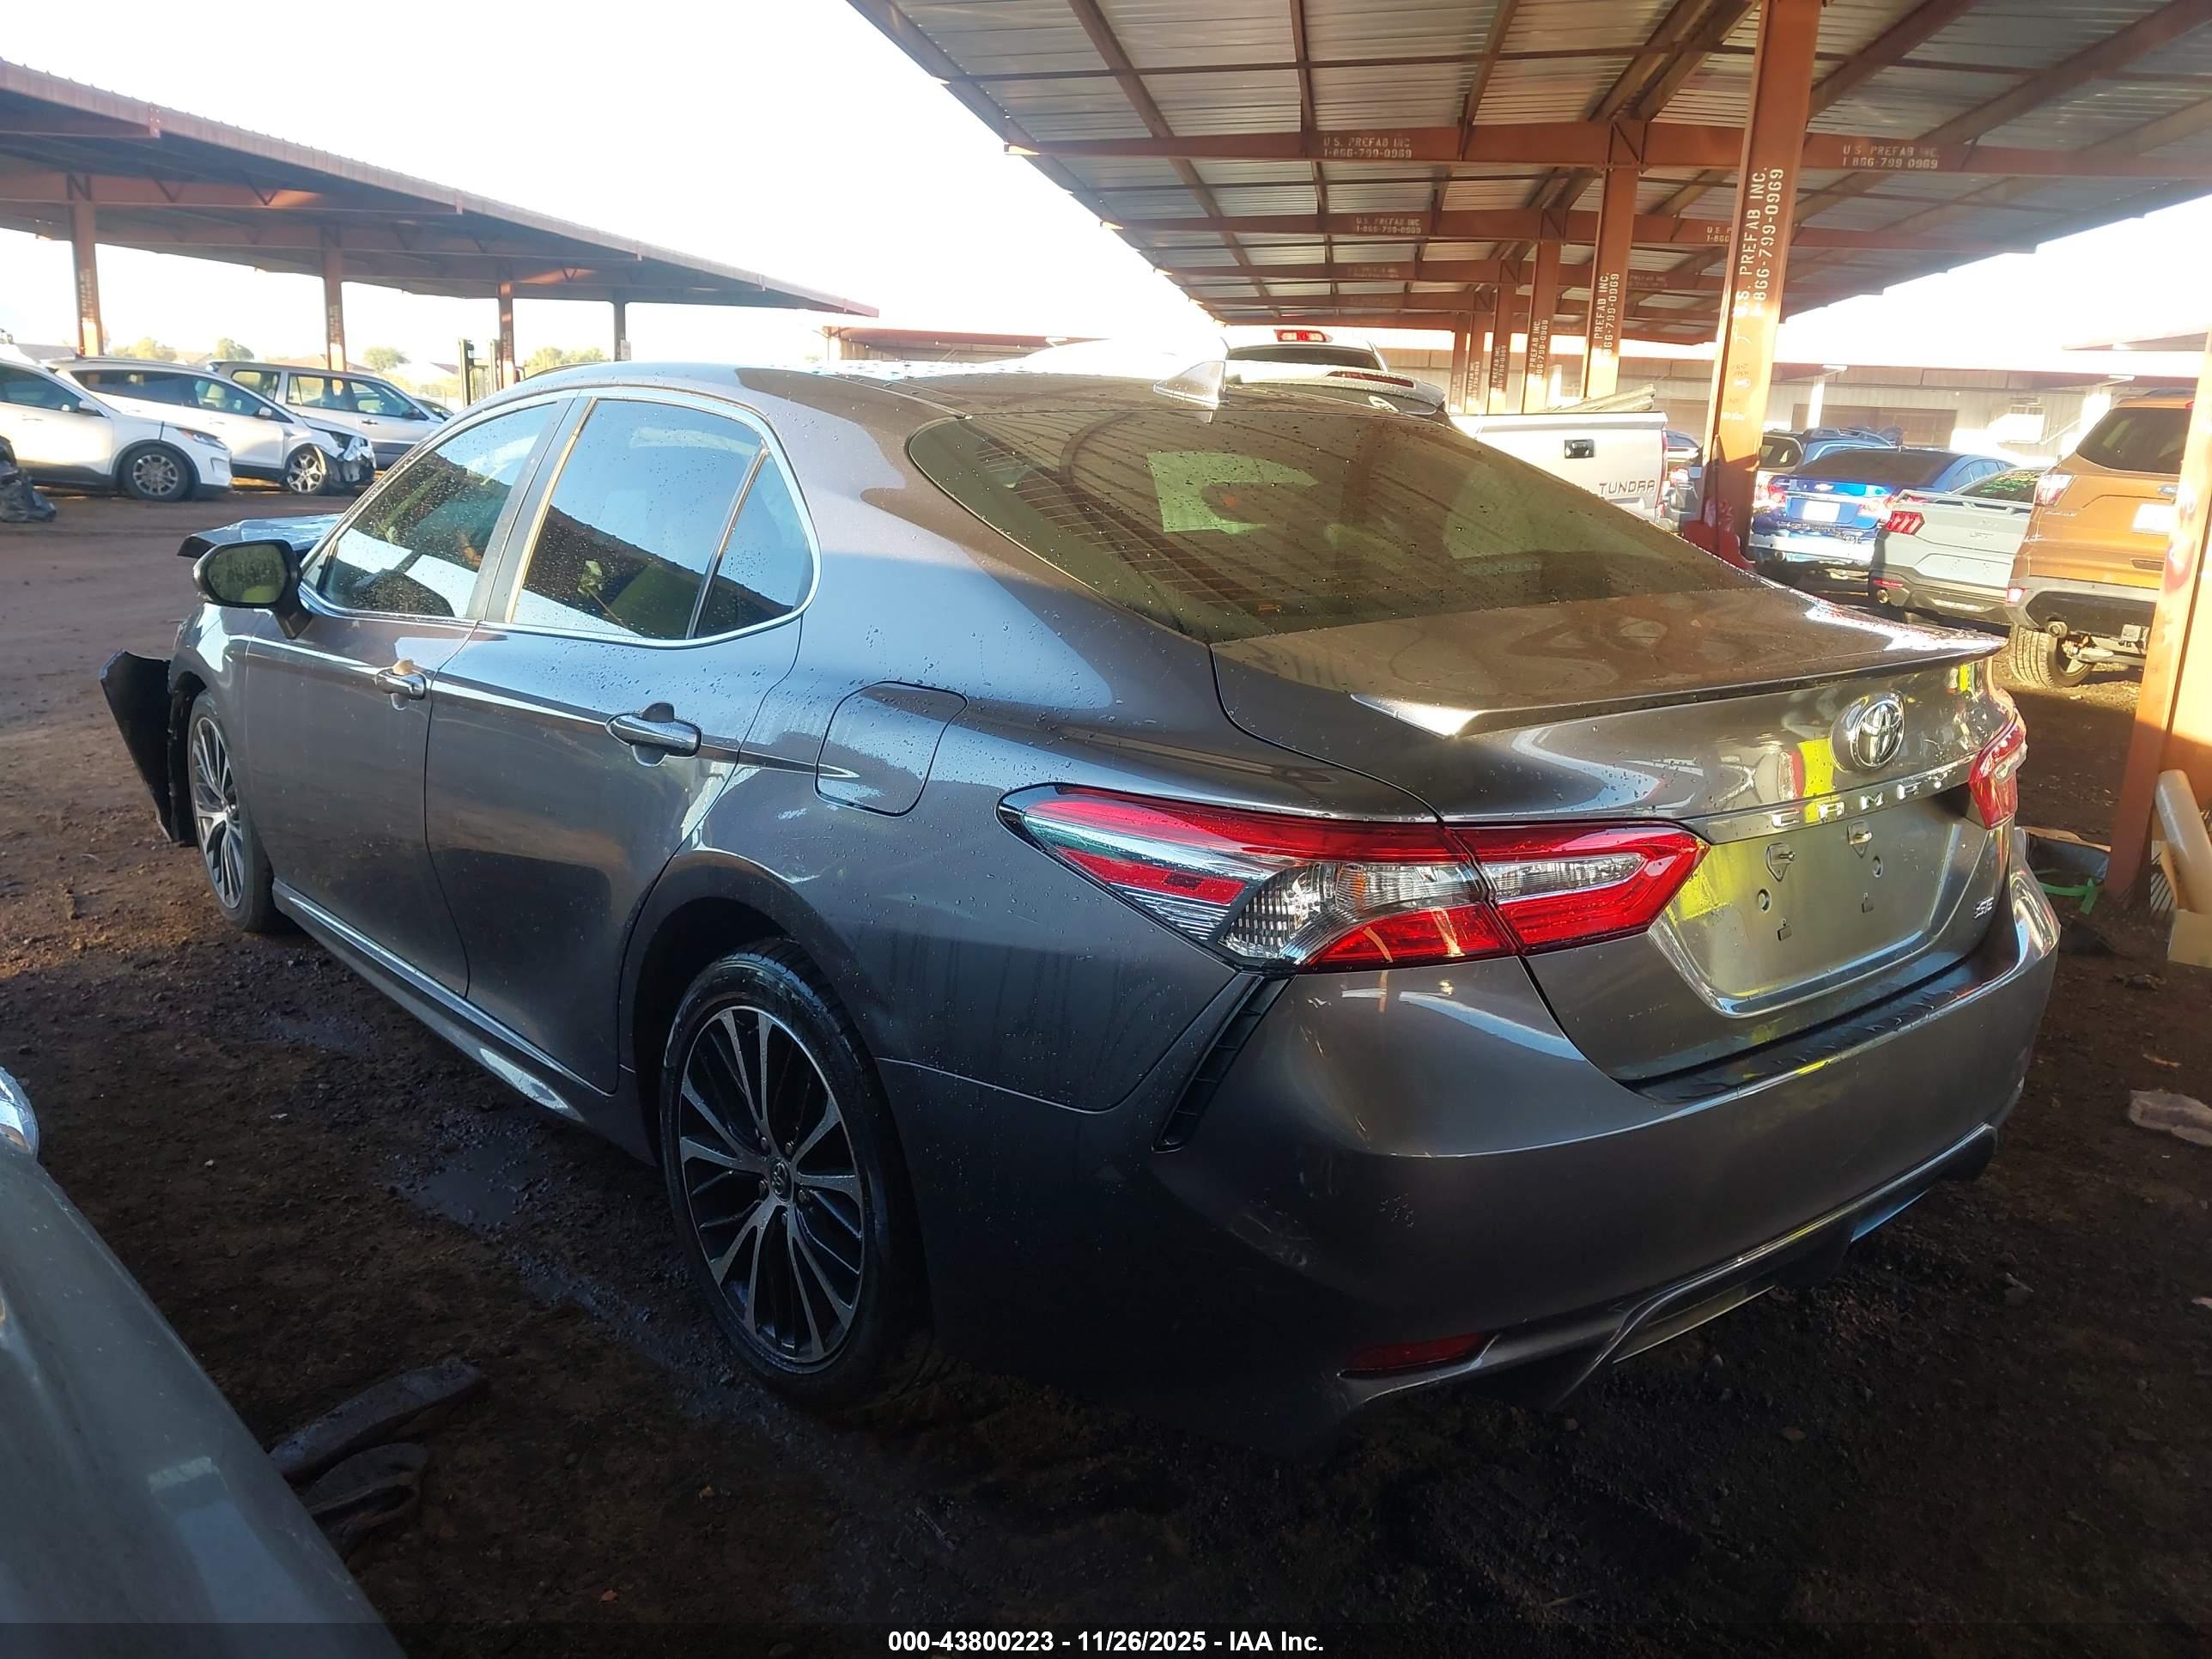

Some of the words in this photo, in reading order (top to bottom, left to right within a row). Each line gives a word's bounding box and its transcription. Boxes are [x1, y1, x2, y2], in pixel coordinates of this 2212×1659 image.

[1348, 137, 1389, 147] PREFAB
[1870, 146, 1914, 156] PREFAB
[1749, 167, 1767, 199] INC.
[1739, 209, 1761, 275] PREFAB
[1598, 272, 1609, 293] INC.
[1594, 298, 1607, 339] PREFAB
[1599, 480, 1656, 496] TUNDRA
